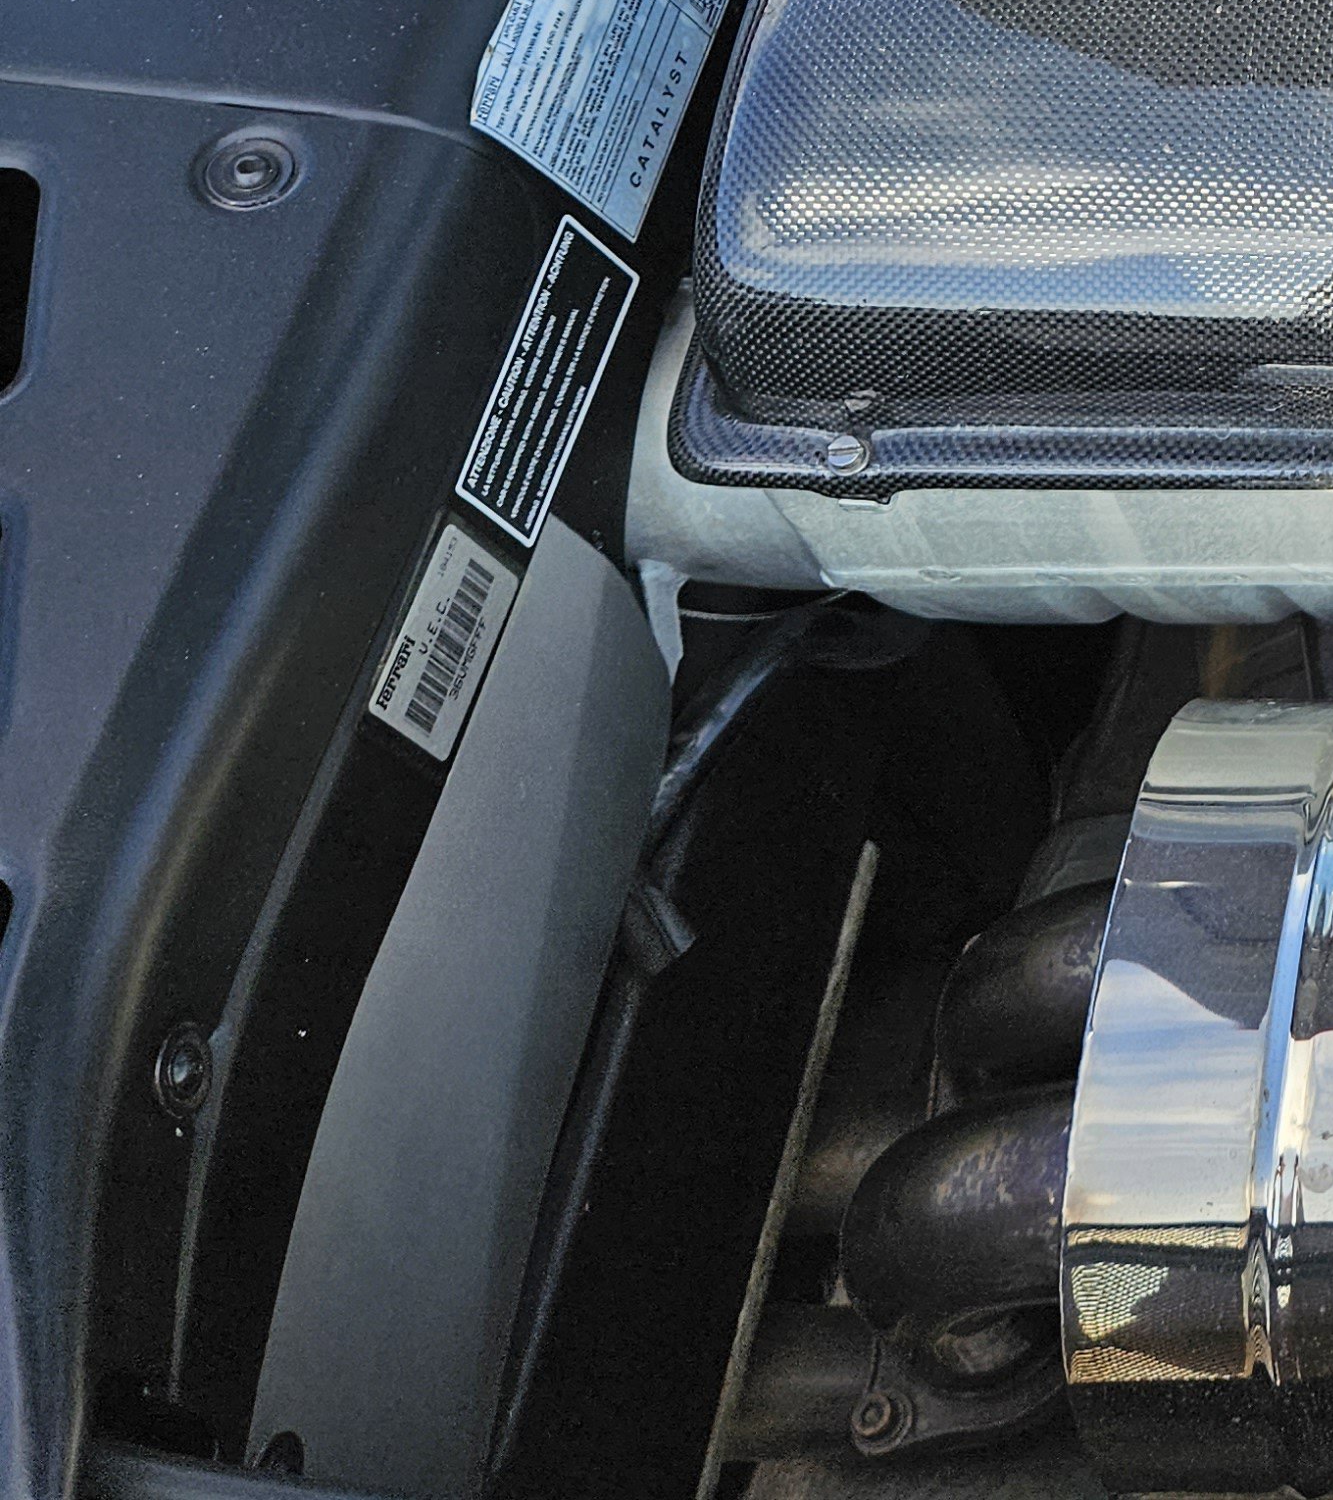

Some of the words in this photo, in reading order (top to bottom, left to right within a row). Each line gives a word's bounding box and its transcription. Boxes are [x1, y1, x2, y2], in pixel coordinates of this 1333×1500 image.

[629, 50, 690, 188] CATALYST
[466, 413, 502, 489] ATTENZIONE
[497, 354, 525, 410] CAUTION
[519, 287, 552, 351] ATTENTION
[545, 228, 575, 285] ACHTUNG
[375, 633, 416, 711] Ferrari
